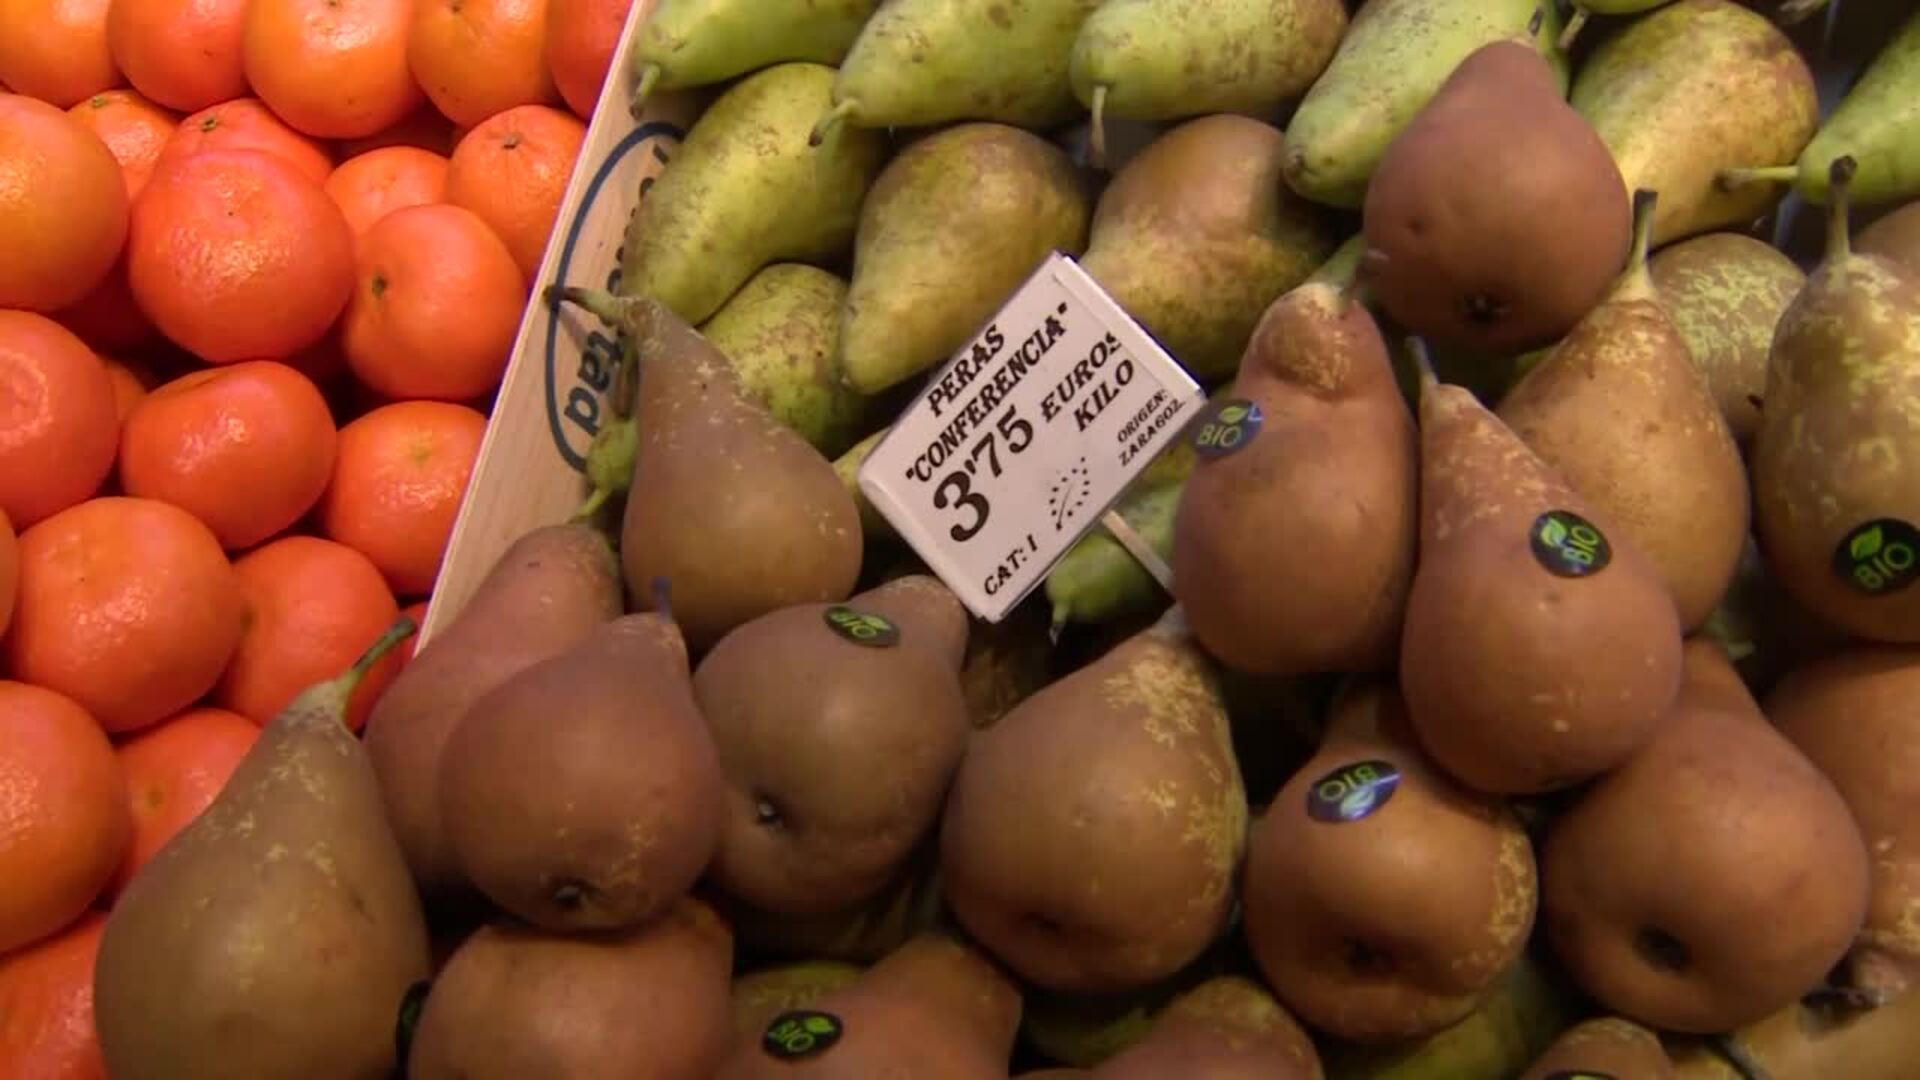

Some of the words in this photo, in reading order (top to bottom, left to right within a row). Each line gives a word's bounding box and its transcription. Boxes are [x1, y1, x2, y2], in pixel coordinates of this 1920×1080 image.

[905, 302, 1067, 483] "CONFERENCIA"
[926, 325, 1005, 418] PERAS
[1073, 359, 1133, 432] KILO
[1117, 388, 1168, 442] ORIGEN:
[1119, 398, 1187, 467] ZARAGOZ
[1197, 423, 1242, 448] BIO
[933, 404, 1033, 543] 3'75
[1563, 525, 1600, 566] BIO
[1854, 542, 1915, 590] BIO
[984, 547, 1028, 596] CAT:
[1320, 765, 1378, 801] BIO
[768, 1019, 815, 1053] BIO
